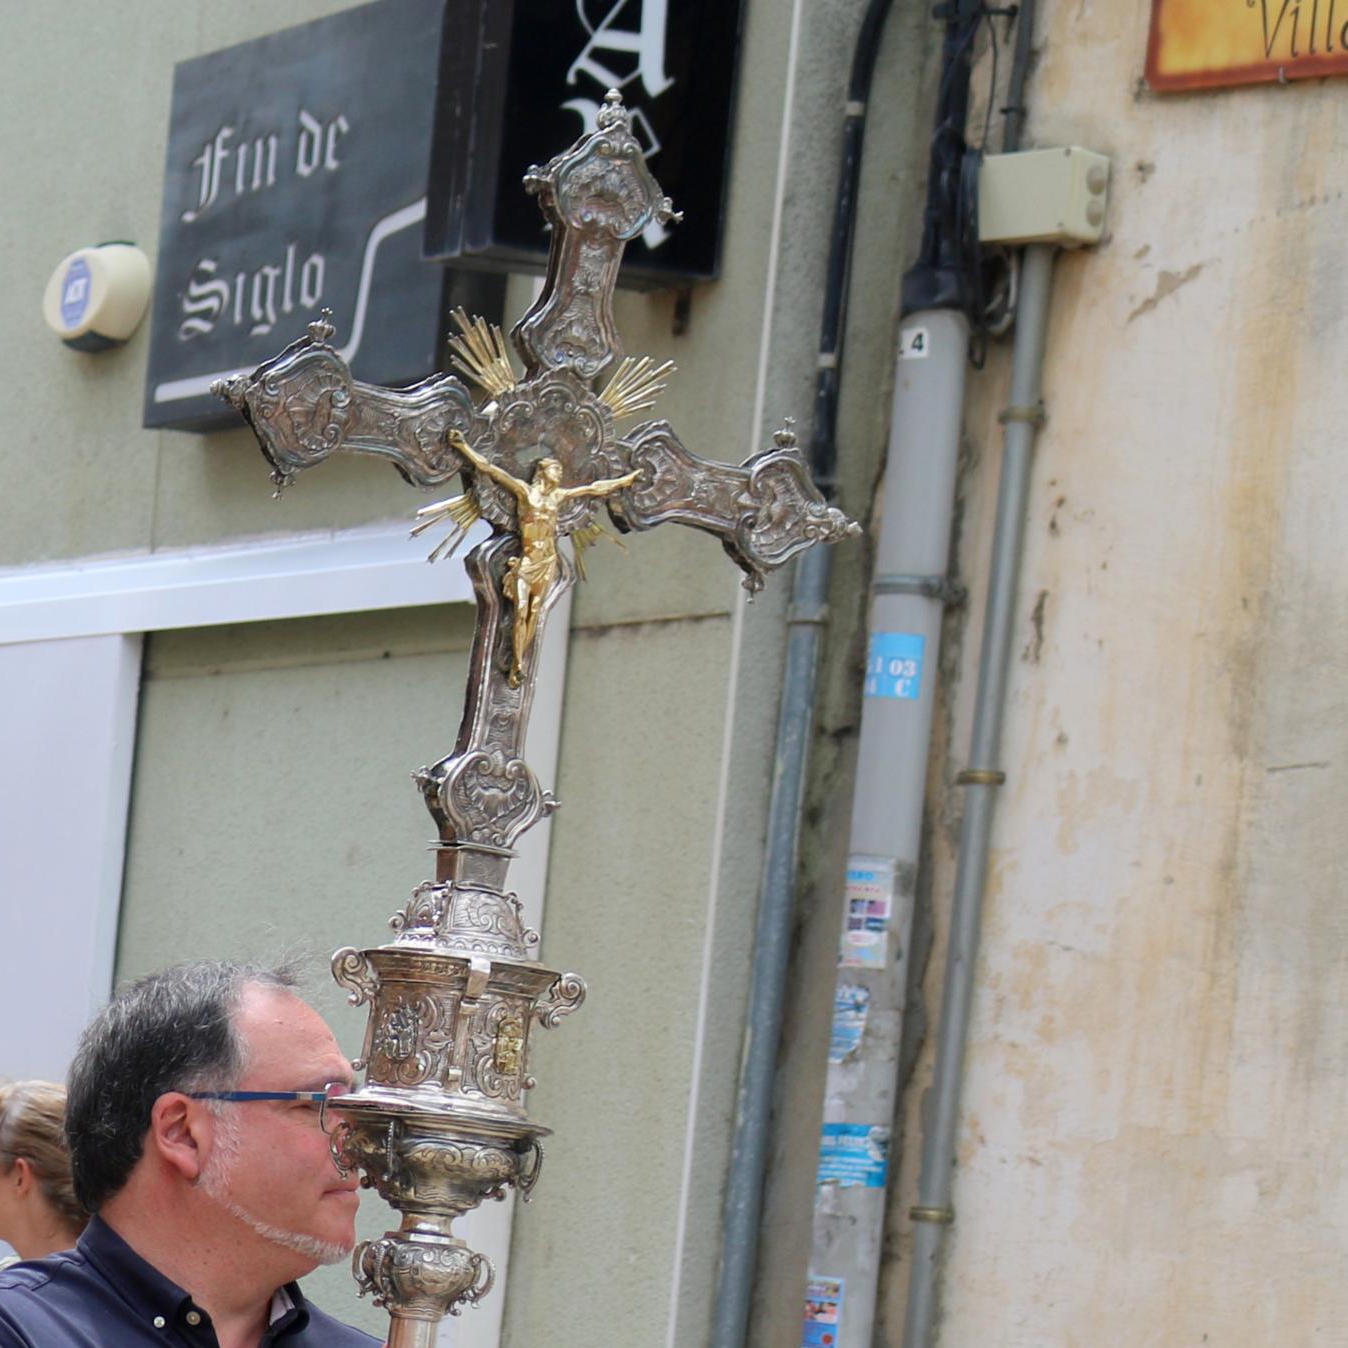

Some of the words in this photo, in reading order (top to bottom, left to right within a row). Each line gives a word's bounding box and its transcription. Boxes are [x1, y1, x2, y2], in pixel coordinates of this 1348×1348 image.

[181, 126, 278, 223] Fin
[296, 109, 349, 177] de
[178, 241, 325, 341] Siglo
[911, 332, 924, 352] 4
